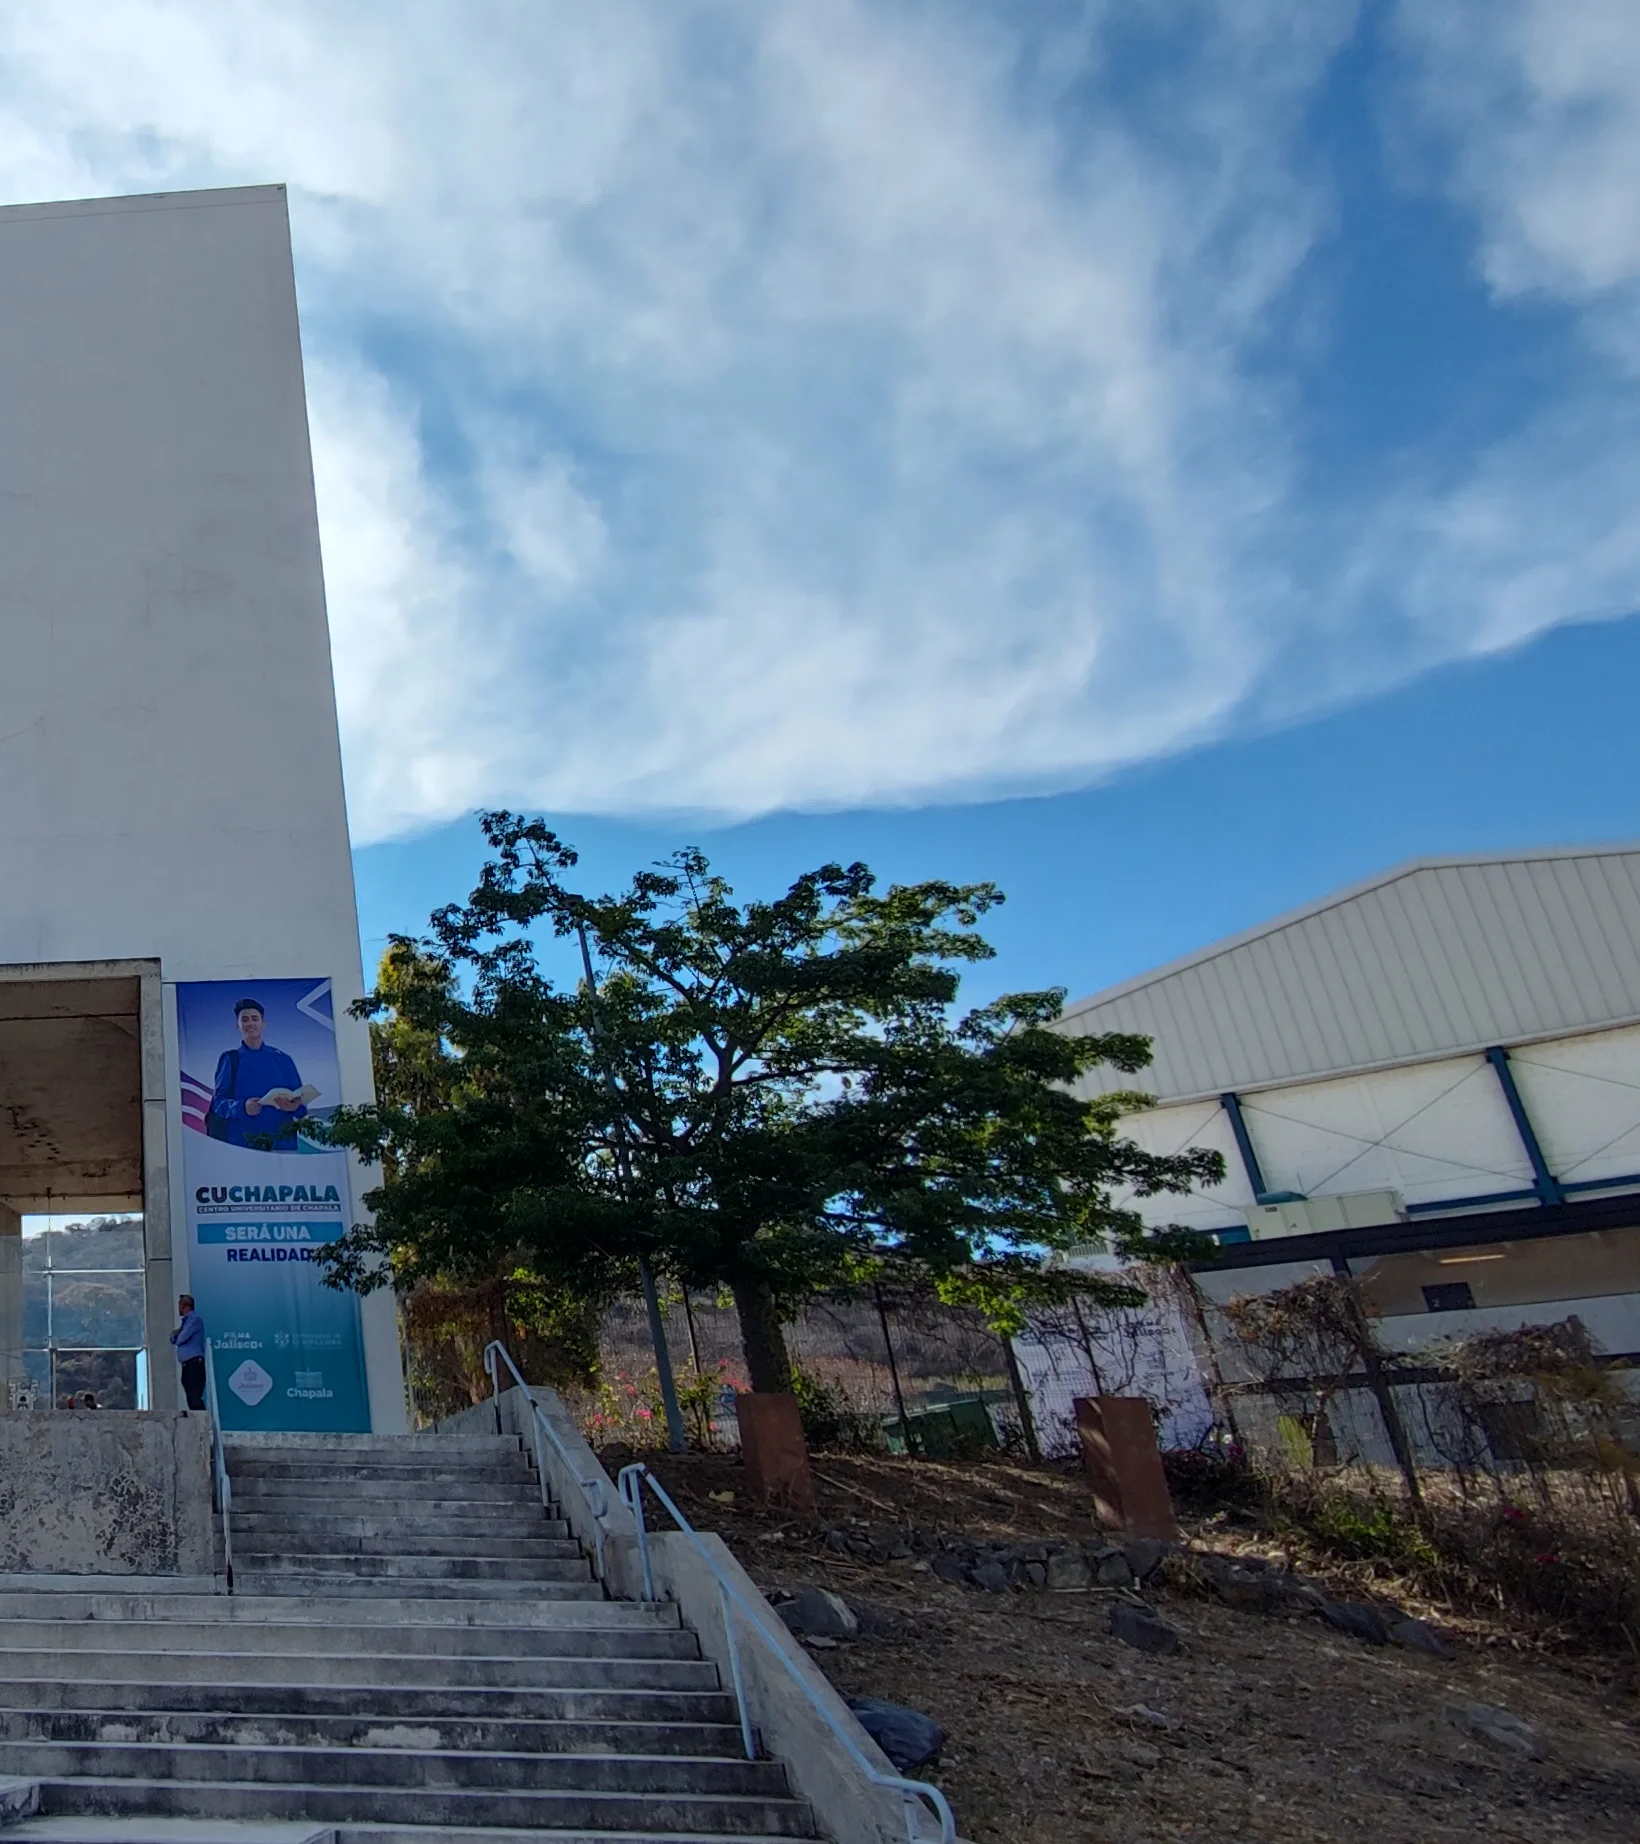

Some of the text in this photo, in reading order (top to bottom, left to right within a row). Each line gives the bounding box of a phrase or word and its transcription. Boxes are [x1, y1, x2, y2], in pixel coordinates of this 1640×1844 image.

[196, 1185, 340, 1204] CUCHAPALA
[231, 1204, 288, 1212] UNIVERSITARIO
[225, 1223, 311, 1240] SERÁ UNA
[227, 1248, 311, 1262] REALIDAD
[286, 1388, 333, 1399] Chapala
